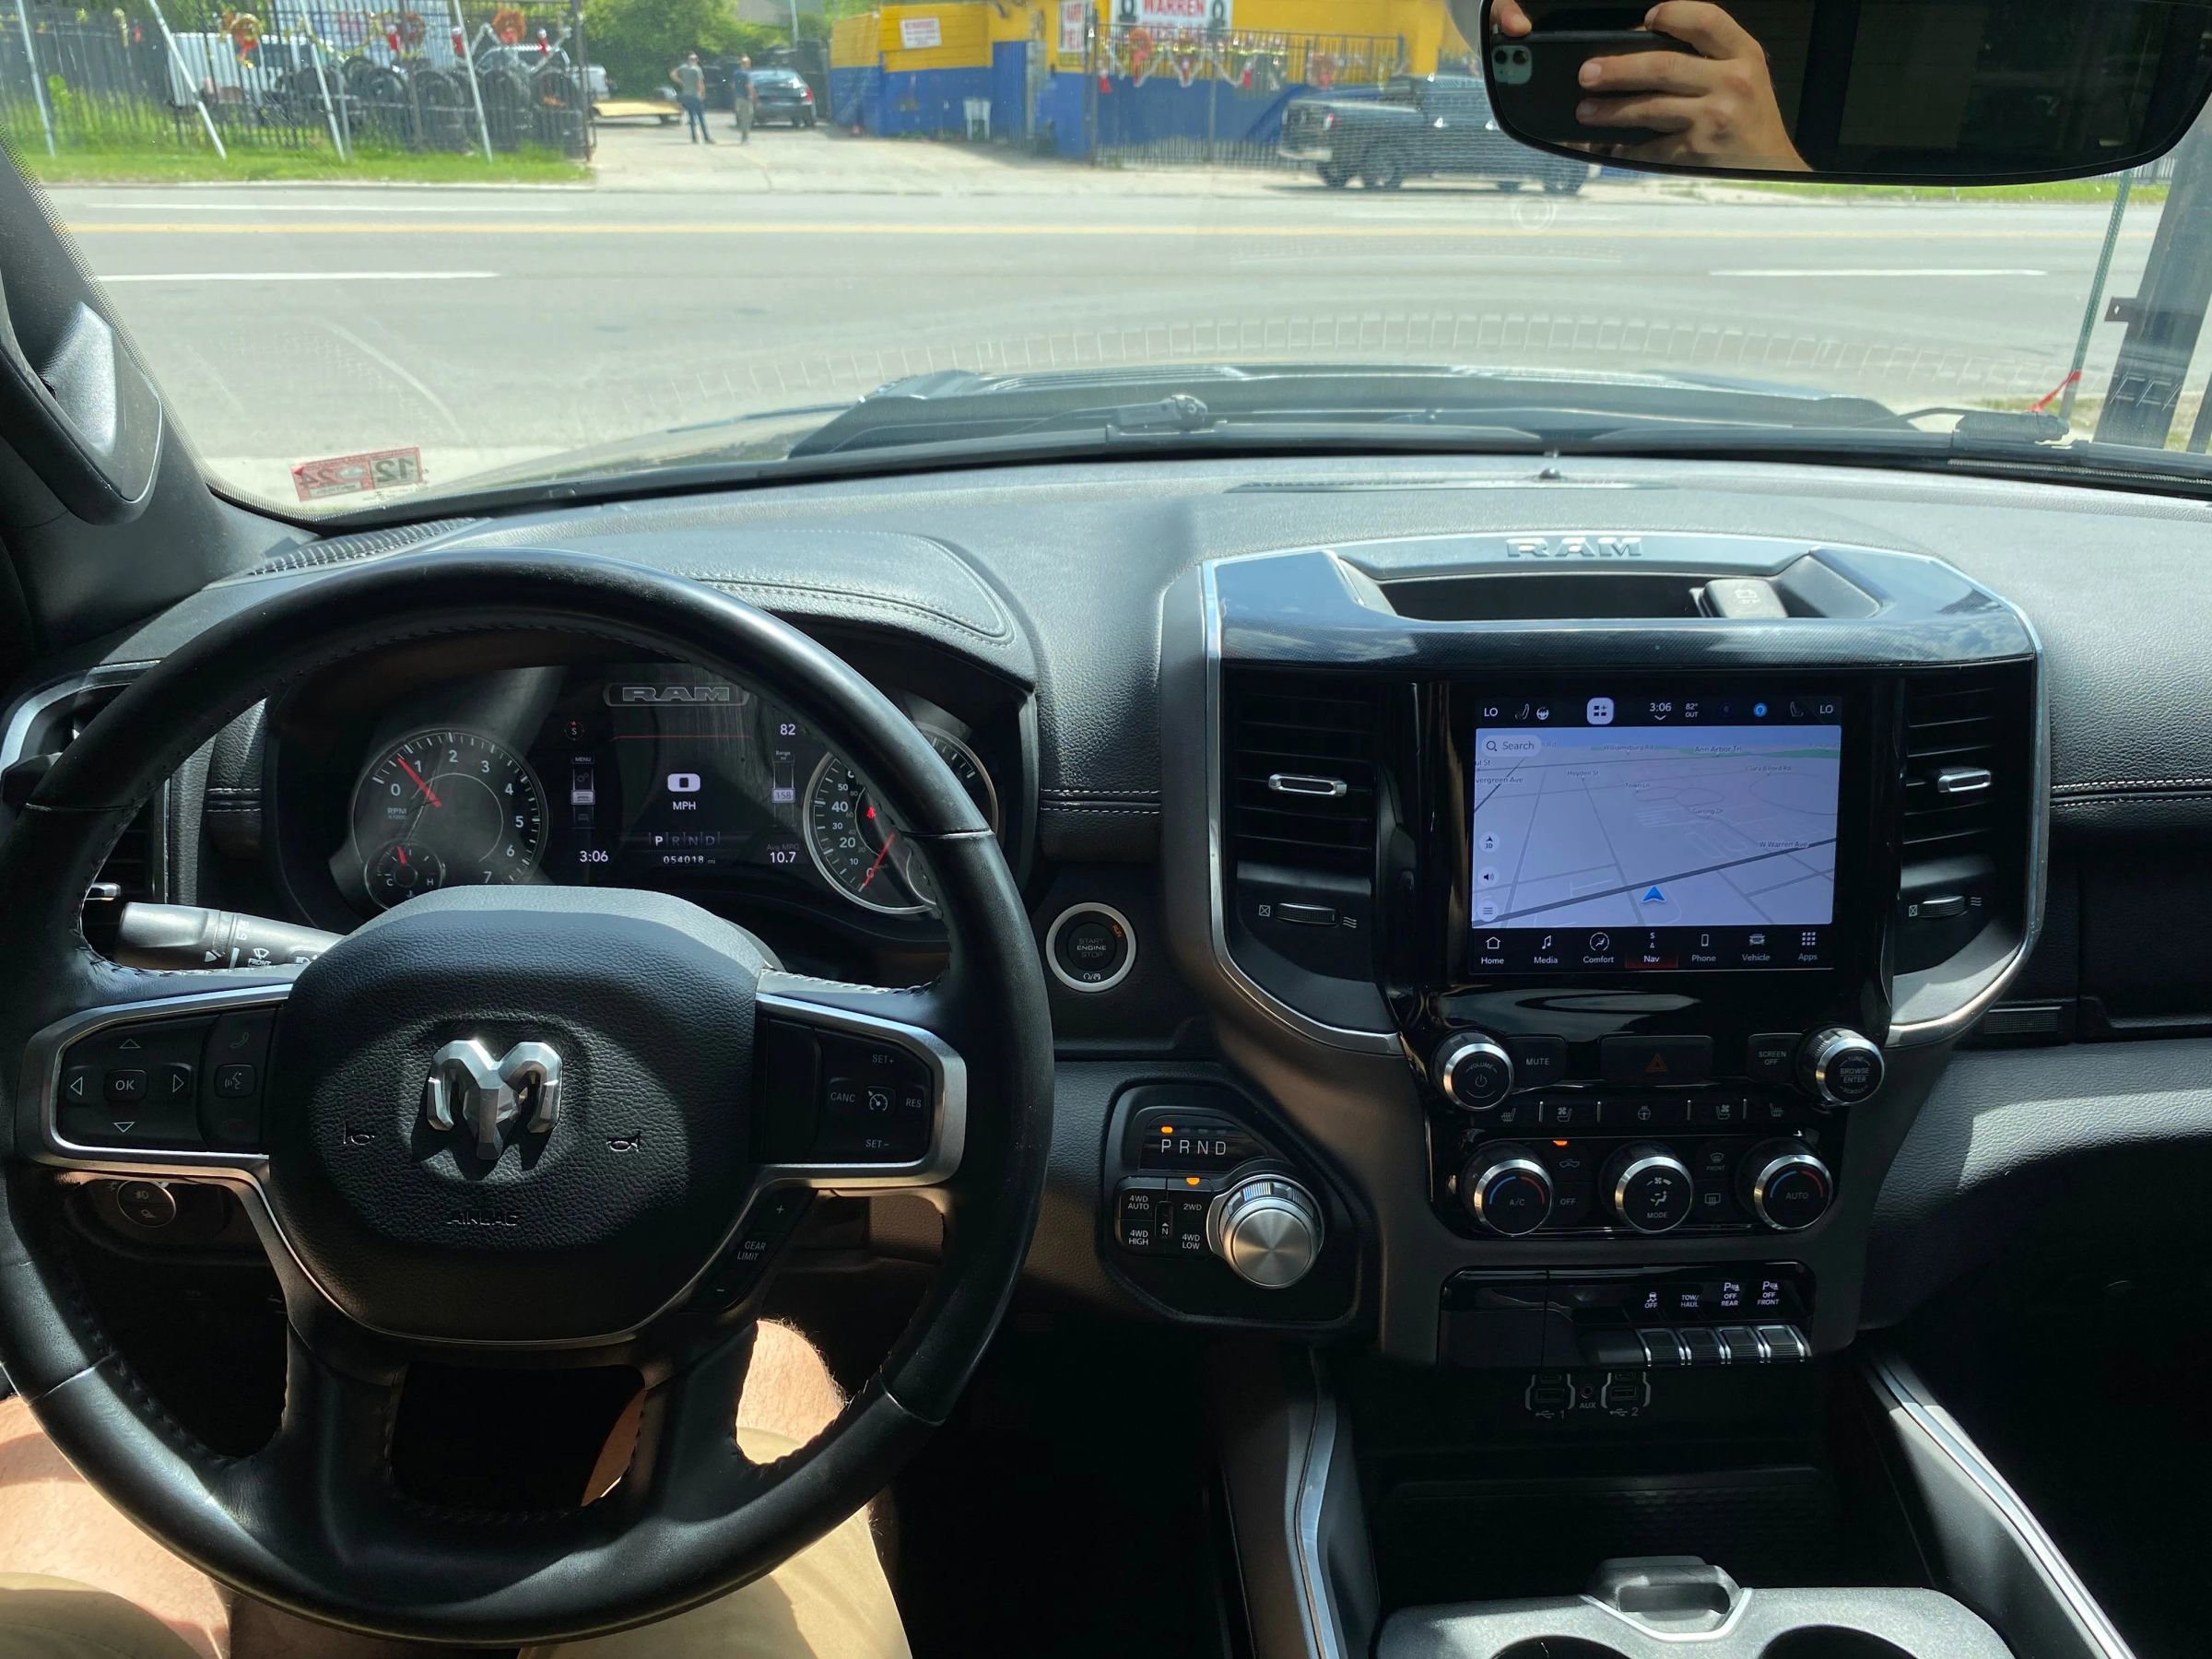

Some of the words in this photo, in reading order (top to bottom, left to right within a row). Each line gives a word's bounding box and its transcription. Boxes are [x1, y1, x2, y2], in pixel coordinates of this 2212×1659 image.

[1505, 536, 1642, 558] RAM
[622, 687, 729, 701] RAM
[1484, 707, 1499, 717] LO
[1649, 702, 1673, 712] 3:06
[1819, 704, 1834, 714] LO
[780, 724, 796, 735] 82
[1502, 741, 1534, 751] Search
[449, 750, 458, 763] 2
[414, 760, 422, 773] 1
[481, 760, 490, 773] 3
[667, 772, 701, 793] 0
[390, 782, 401, 797] 0
[504, 782, 514, 796] 4
[673, 801, 697, 811] MPH
[831, 801, 849, 813] 40
[515, 816, 524, 829] 5
[654, 835, 665, 846] P
[839, 837, 856, 849] 20
[506, 844, 515, 858] 6
[579, 851, 609, 863] 3:06
[664, 855, 704, 864] 054018
[771, 851, 796, 864] 10.7
[386, 877, 394, 887] C
[426, 877, 434, 887] H
[483, 870, 493, 884] 7
[1481, 957, 1505, 965] Home
[1534, 956, 1559, 964] Media
[1583, 955, 1615, 964] Comfort
[1643, 955, 1660, 963] Nav
[1691, 954, 1717, 963] Phone
[1742, 953, 1771, 962] Vehicle
[1798, 953, 1818, 962] Apps
[1525, 1057, 1549, 1065] MUTE
[115, 1079, 136, 1091] OK
[1843, 1076, 1866, 1084] ENTER
[830, 1091, 856, 1103] CANC
[905, 1098, 923, 1109] RES
[1160, 1138, 1172, 1154] P
[1179, 1139, 1191, 1155] R
[1197, 1140, 1209, 1156] N
[1215, 1141, 1227, 1156] D
[1129, 1194, 1149, 1203] 4WD
[1785, 1192, 1809, 1200] AUTO
[1127, 1202, 1150, 1210] AUTO
[1182, 1203, 1203, 1211] 2WD
[1509, 1198, 1525, 1206] A/C
[1129, 1230, 1149, 1238] 4WD
[1161, 1227, 1169, 1236] N
[1128, 1237, 1149, 1246] HIGH
[1182, 1233, 1201, 1241] 4WD
[744, 1240, 767, 1252] GEAR
[1182, 1241, 1201, 1250] LOW
[737, 1251, 759, 1262] LIMIT
[1757, 1298, 1780, 1306] FRONT
[1559, 1409, 1566, 1419] 1
[1630, 1406, 1639, 1417] 2
